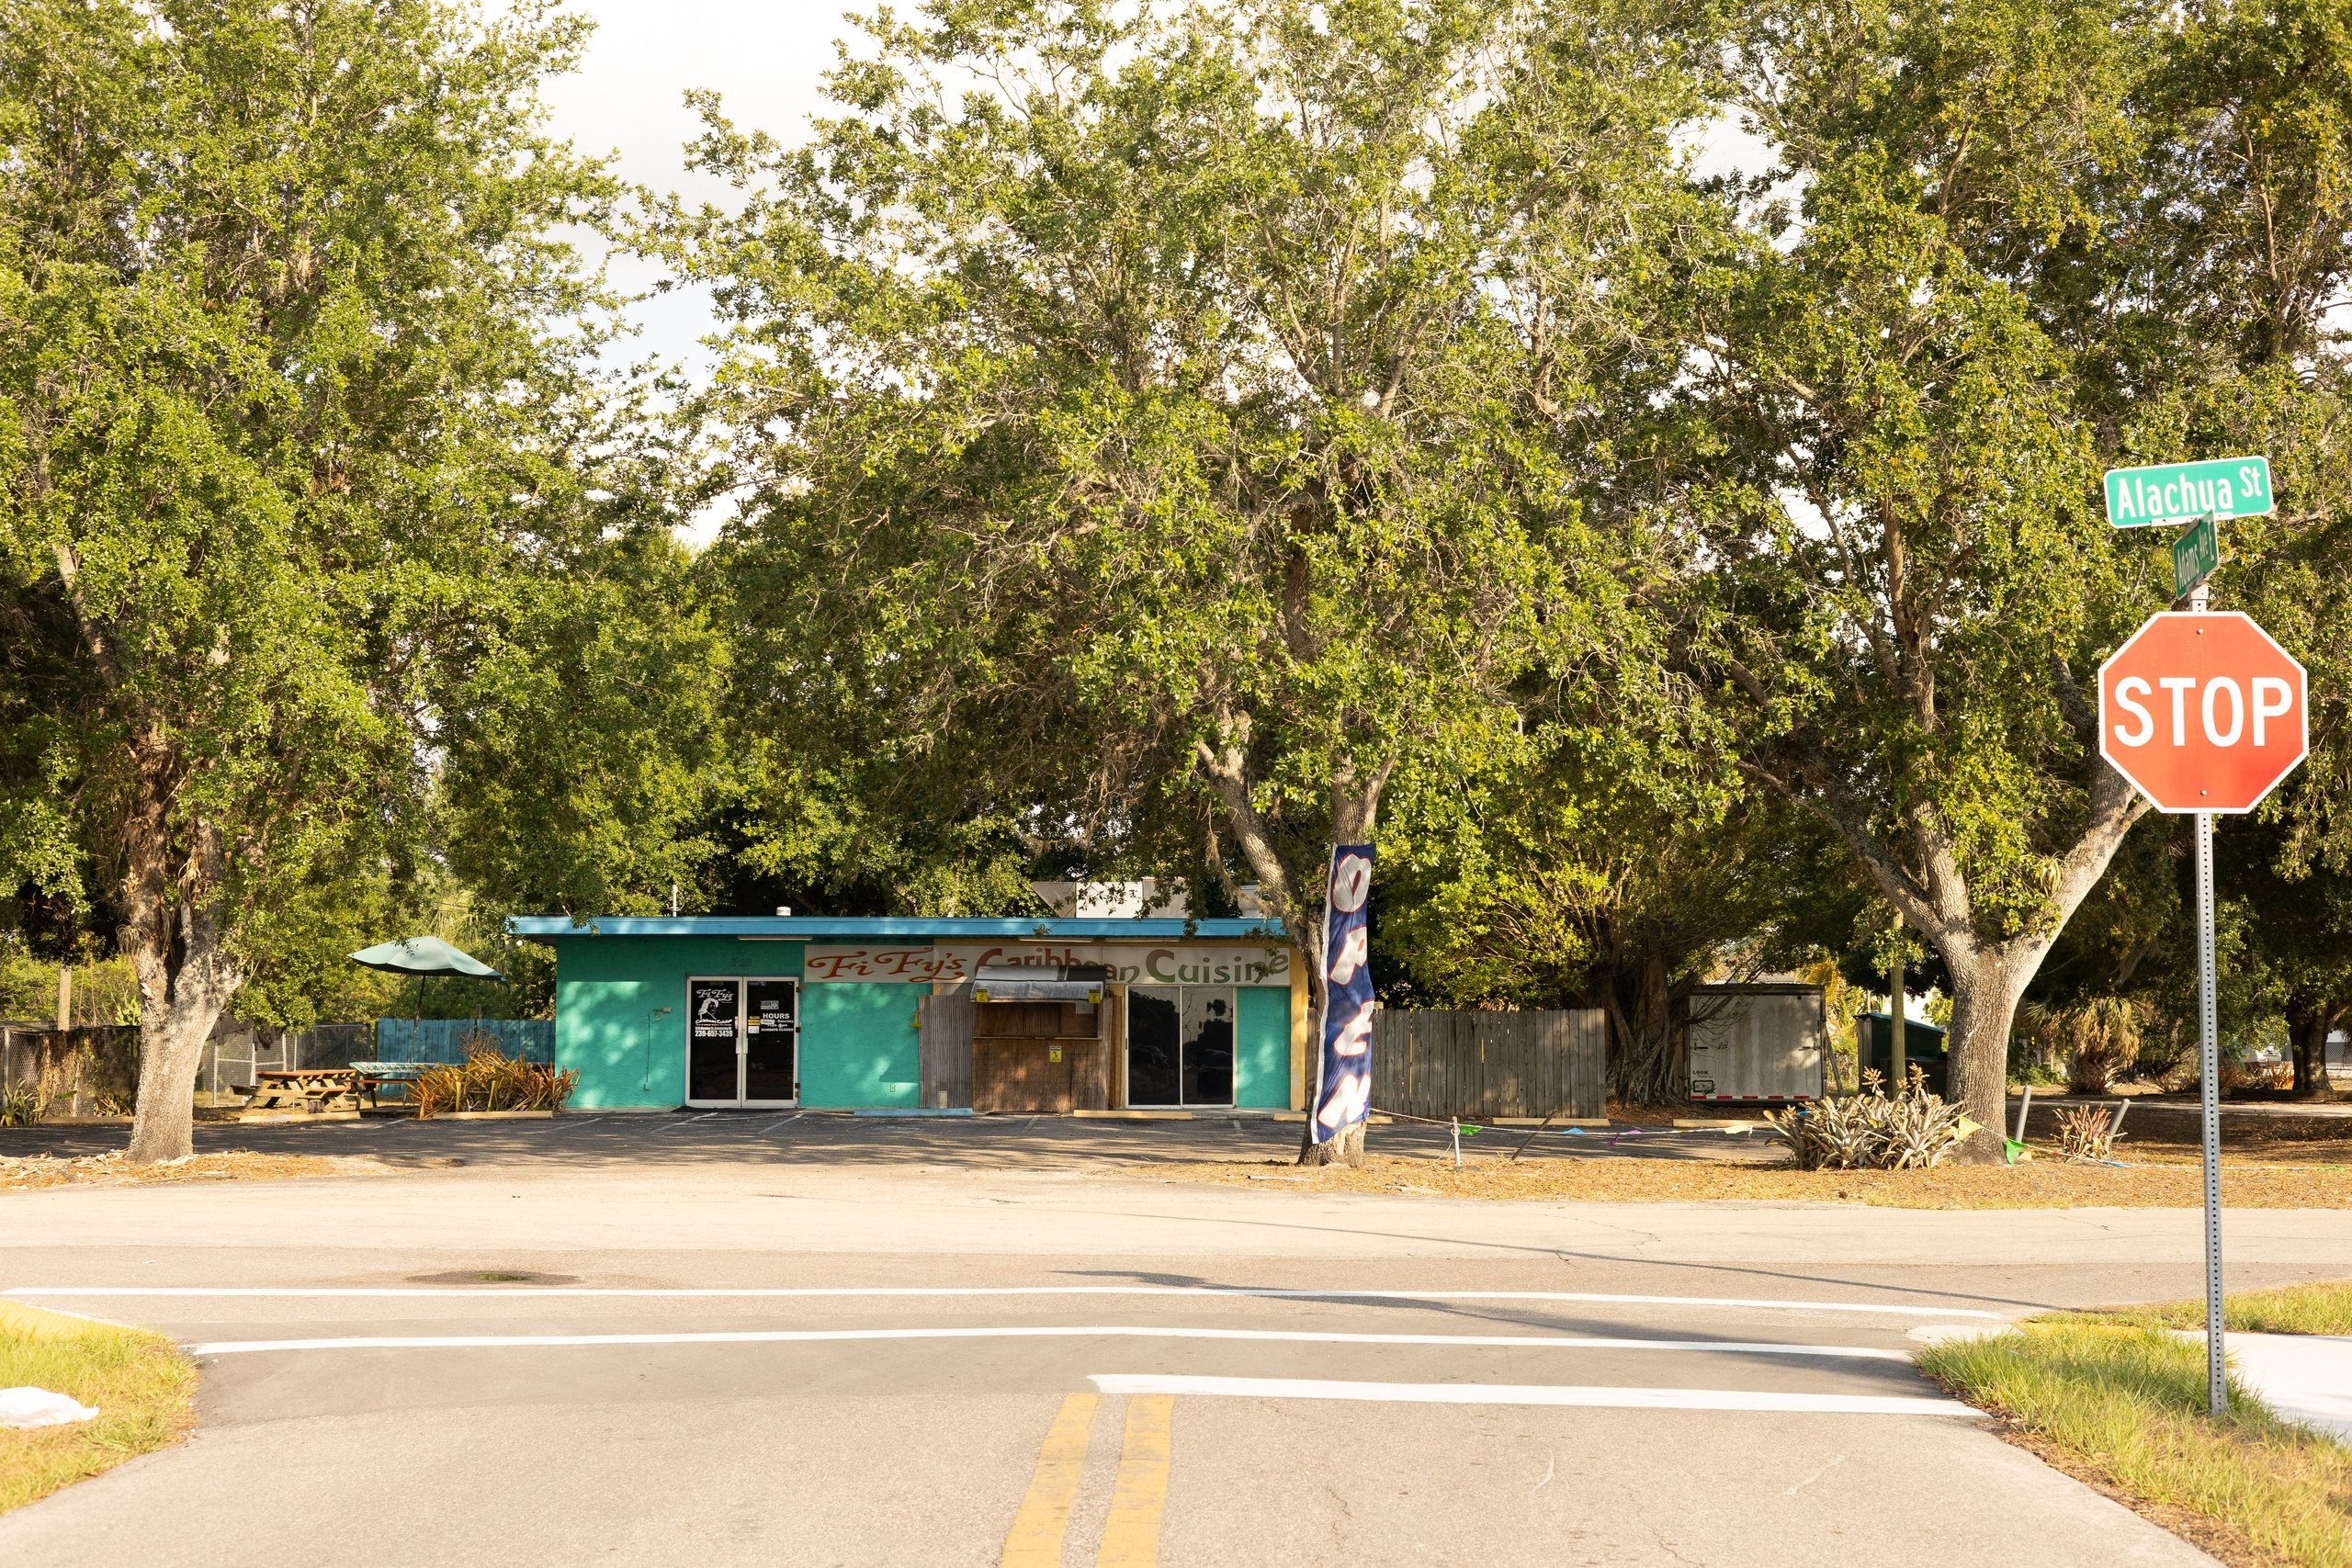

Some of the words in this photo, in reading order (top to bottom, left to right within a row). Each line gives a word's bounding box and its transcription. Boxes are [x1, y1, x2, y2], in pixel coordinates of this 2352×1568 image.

[2117, 472, 2233, 520] Alachua
[2240, 466, 2263, 498] St
[2177, 543, 2200, 590] Adams
[2199, 529, 2209, 561] Ave
[2114, 676, 2292, 748] STOP
[807, 951, 874, 979] Fi
[874, 947, 967, 983] Fy's
[1317, 852, 1374, 1130] OPEN
